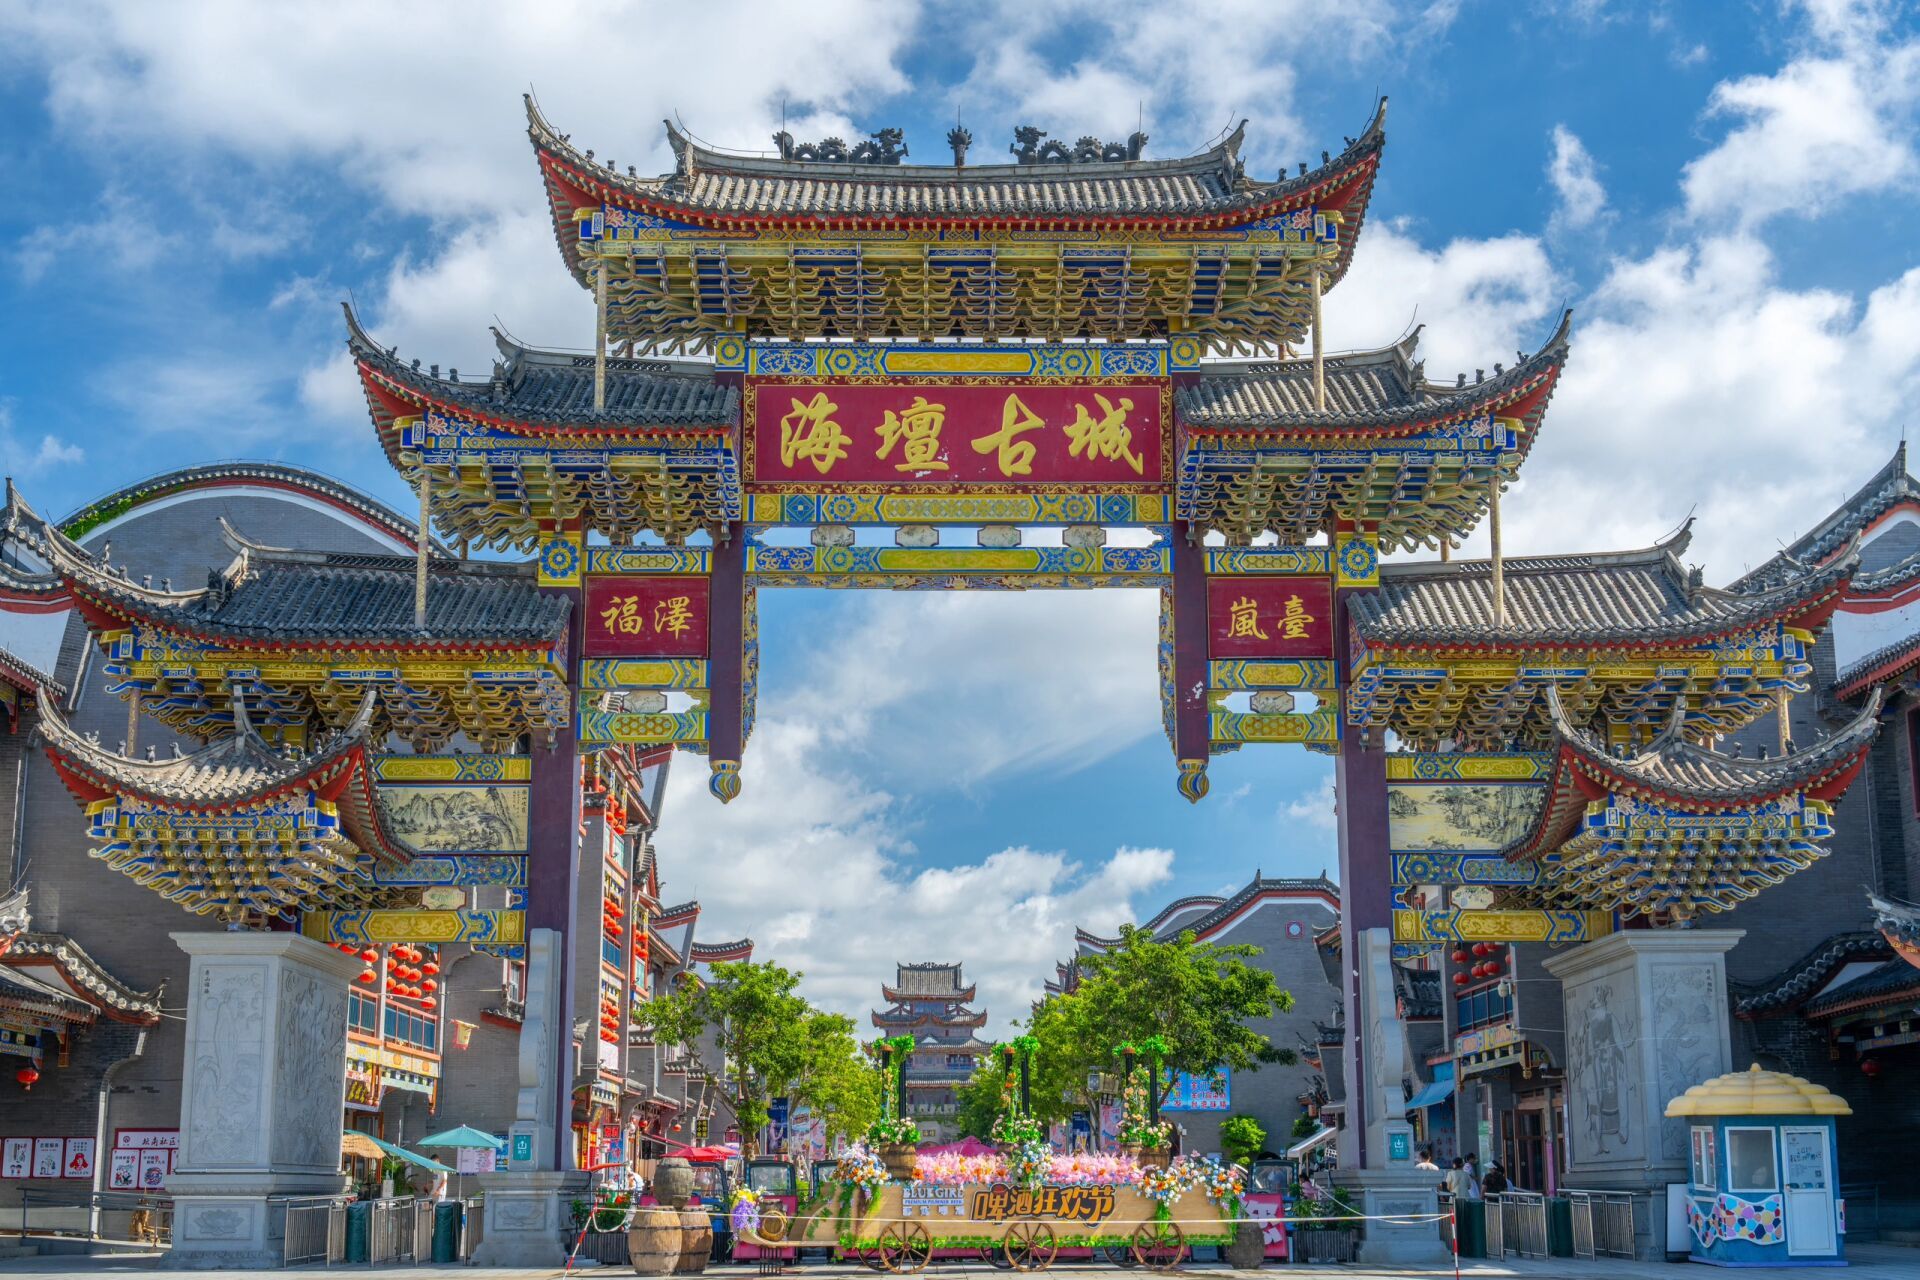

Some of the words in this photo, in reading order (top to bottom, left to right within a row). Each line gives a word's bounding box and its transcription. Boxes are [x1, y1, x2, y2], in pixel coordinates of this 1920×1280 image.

[780, 391, 1144, 478] 海壇古城
[600, 595, 694, 640] 福澤
[1227, 594, 1315, 640] 嵐臺
[973, 1184, 1114, 1223] 啤酒狂欢节
